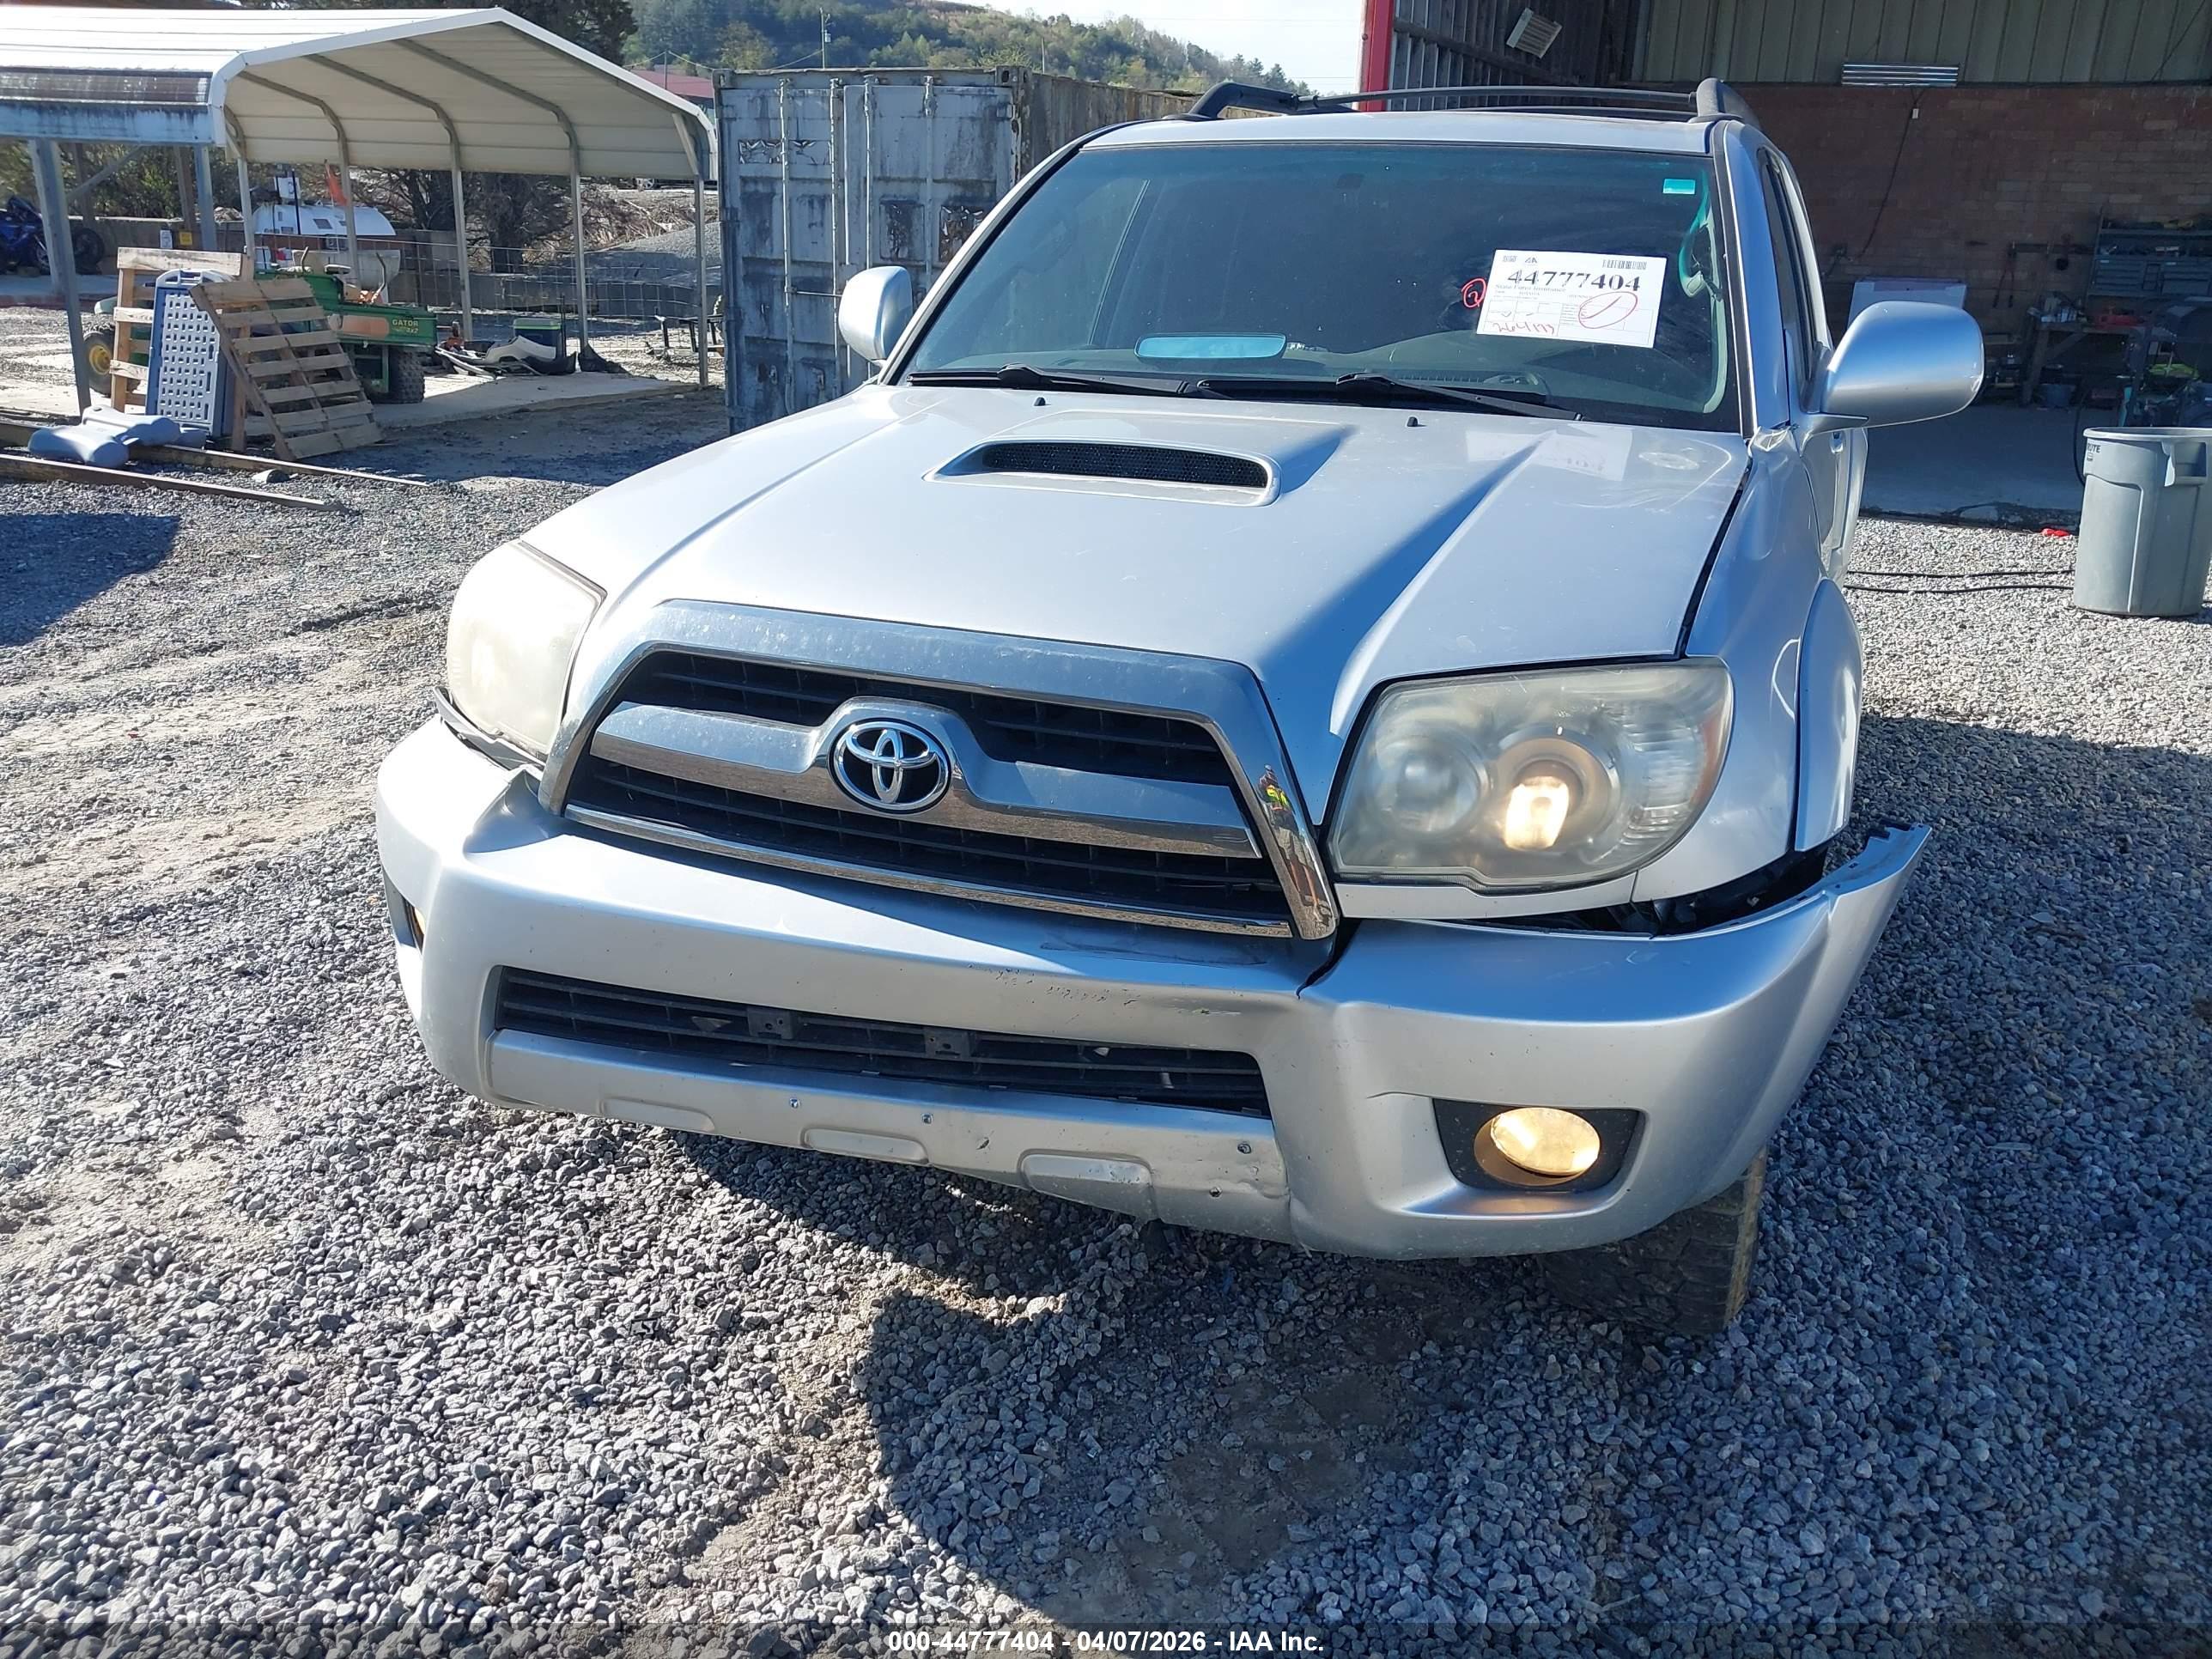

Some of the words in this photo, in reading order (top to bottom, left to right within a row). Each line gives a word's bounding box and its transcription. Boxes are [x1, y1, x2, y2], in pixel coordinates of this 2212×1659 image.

[1507, 270, 1641, 291] 44777404
[392, 319, 419, 327] GATOR
[2087, 442, 2101, 453] RUTE
